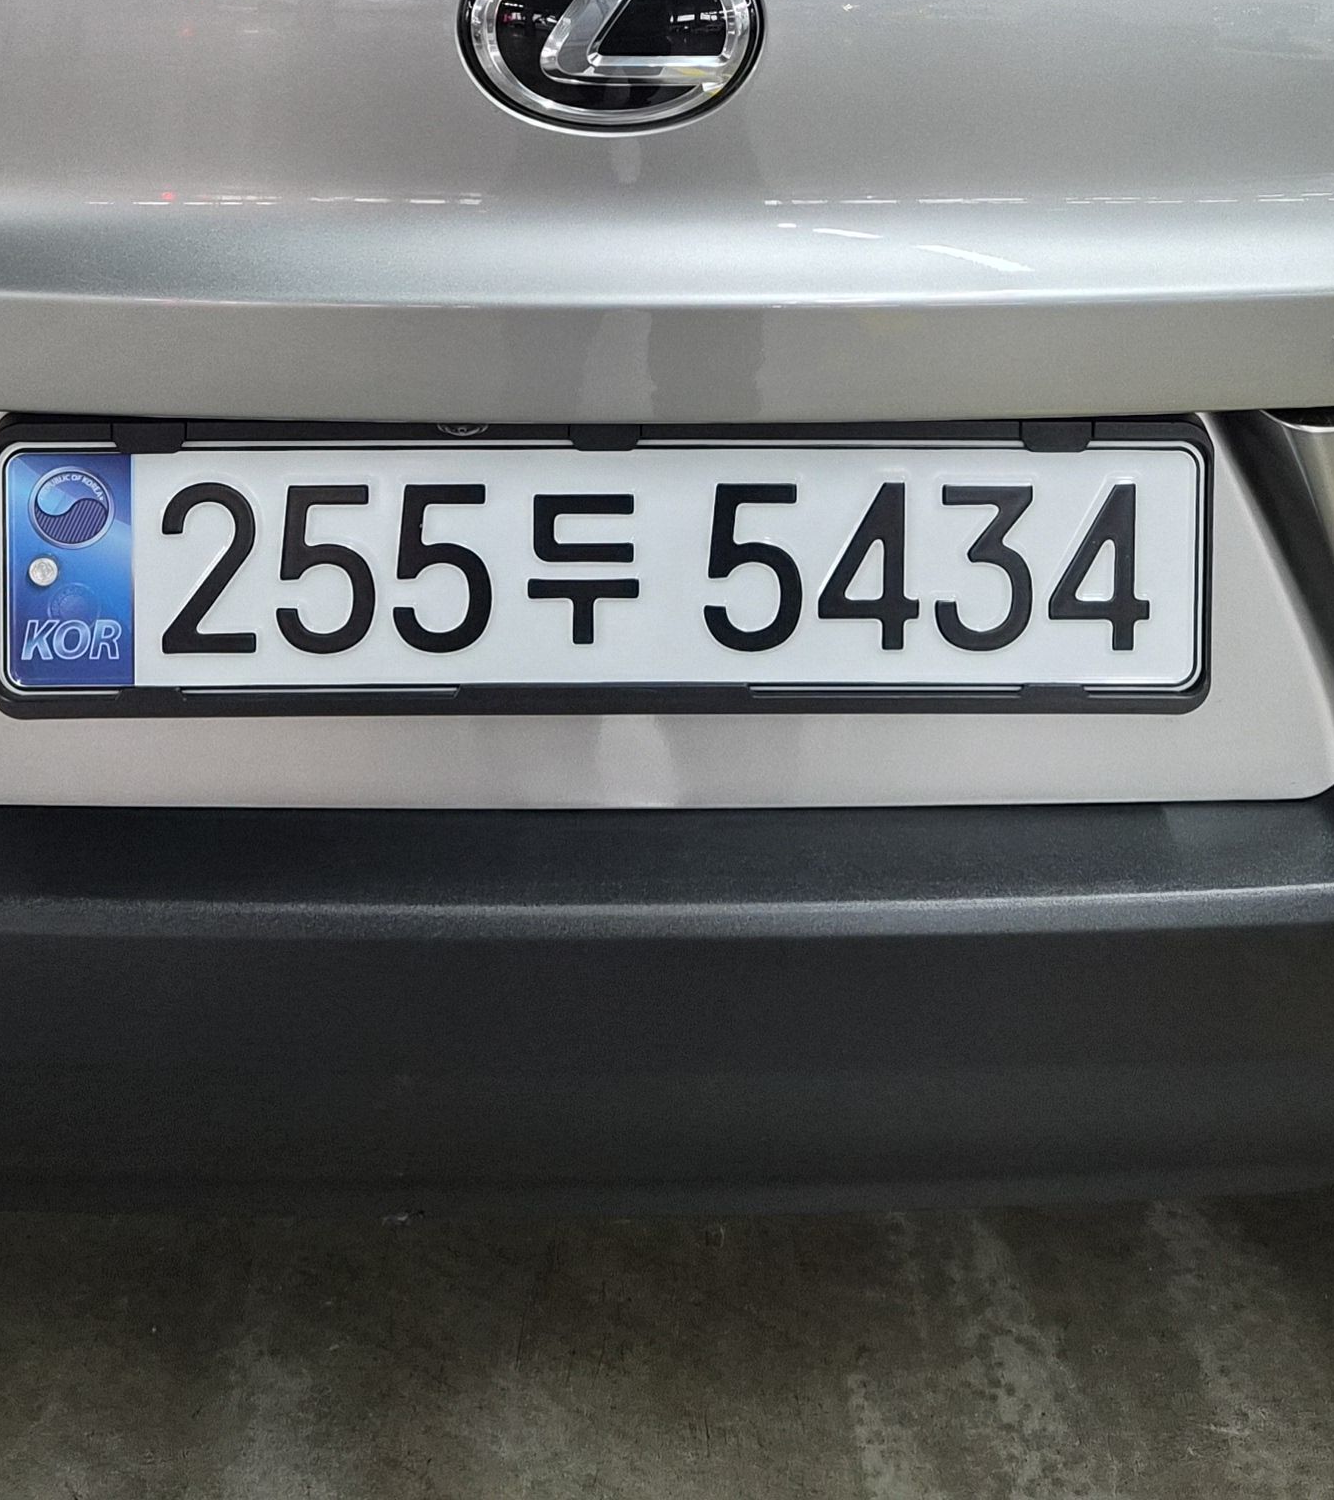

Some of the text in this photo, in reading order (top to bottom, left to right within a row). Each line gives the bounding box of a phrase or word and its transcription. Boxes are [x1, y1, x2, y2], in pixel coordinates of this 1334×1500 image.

[159, 482, 1153, 656] 255두 5434
[21, 619, 122, 660] KOR
